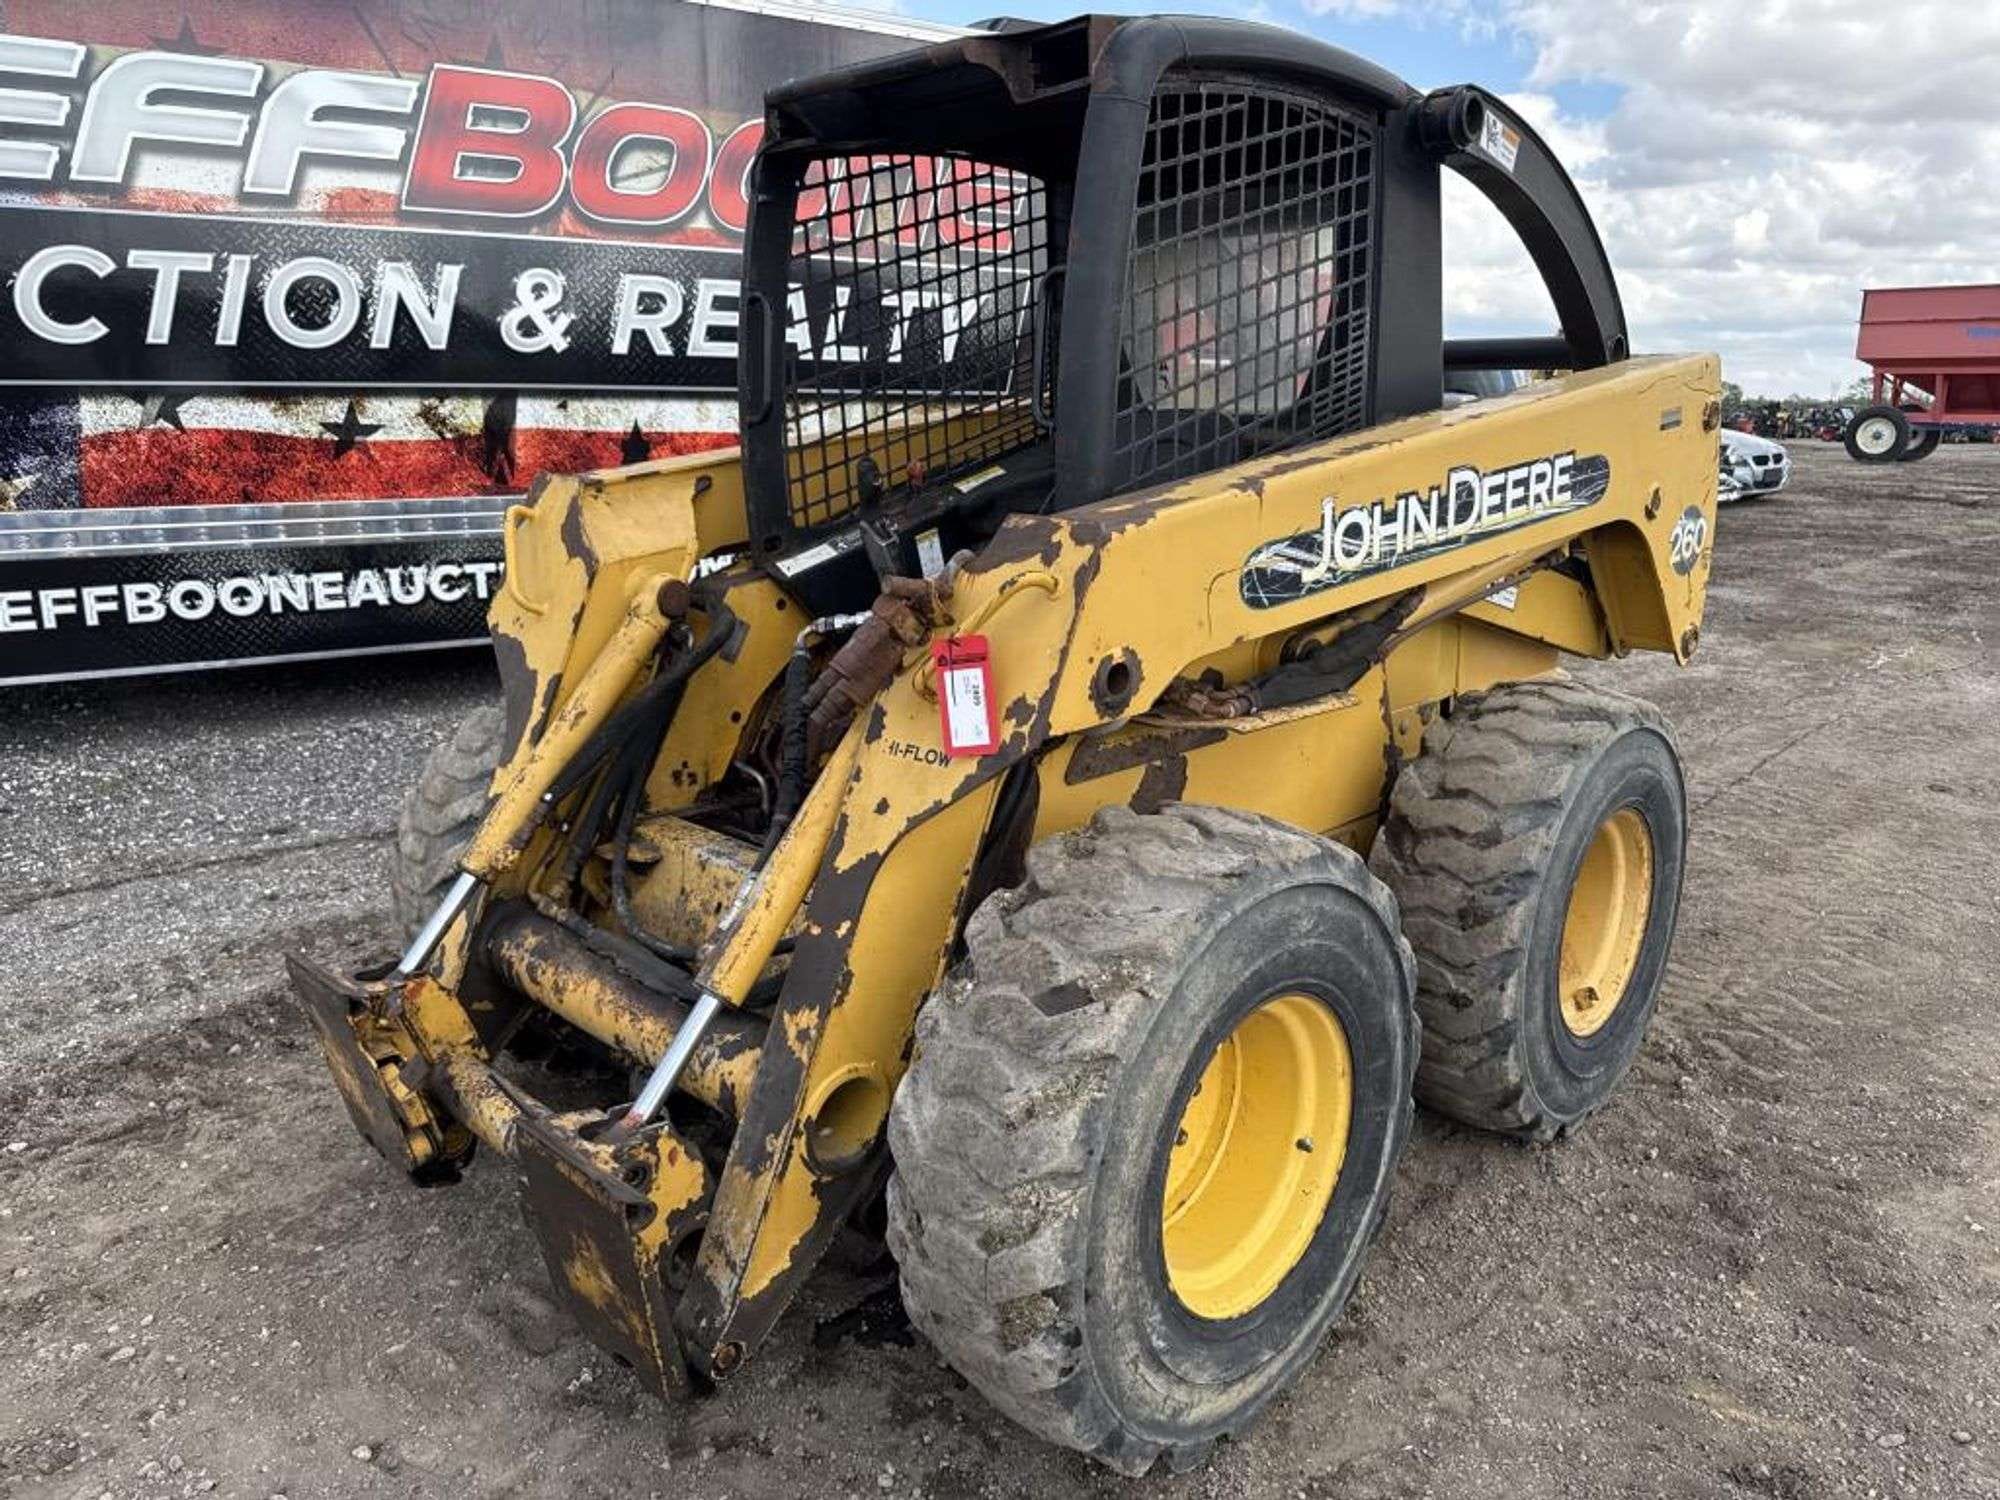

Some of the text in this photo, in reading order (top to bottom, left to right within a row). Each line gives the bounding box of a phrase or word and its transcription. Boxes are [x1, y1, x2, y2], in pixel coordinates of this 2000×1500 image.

[500, 268, 574, 354] &
[1303, 454, 1576, 582] JOHN DEERE
[1670, 516, 1708, 566] 260
[0, 561, 505, 632] EFFBOONEAUCT
